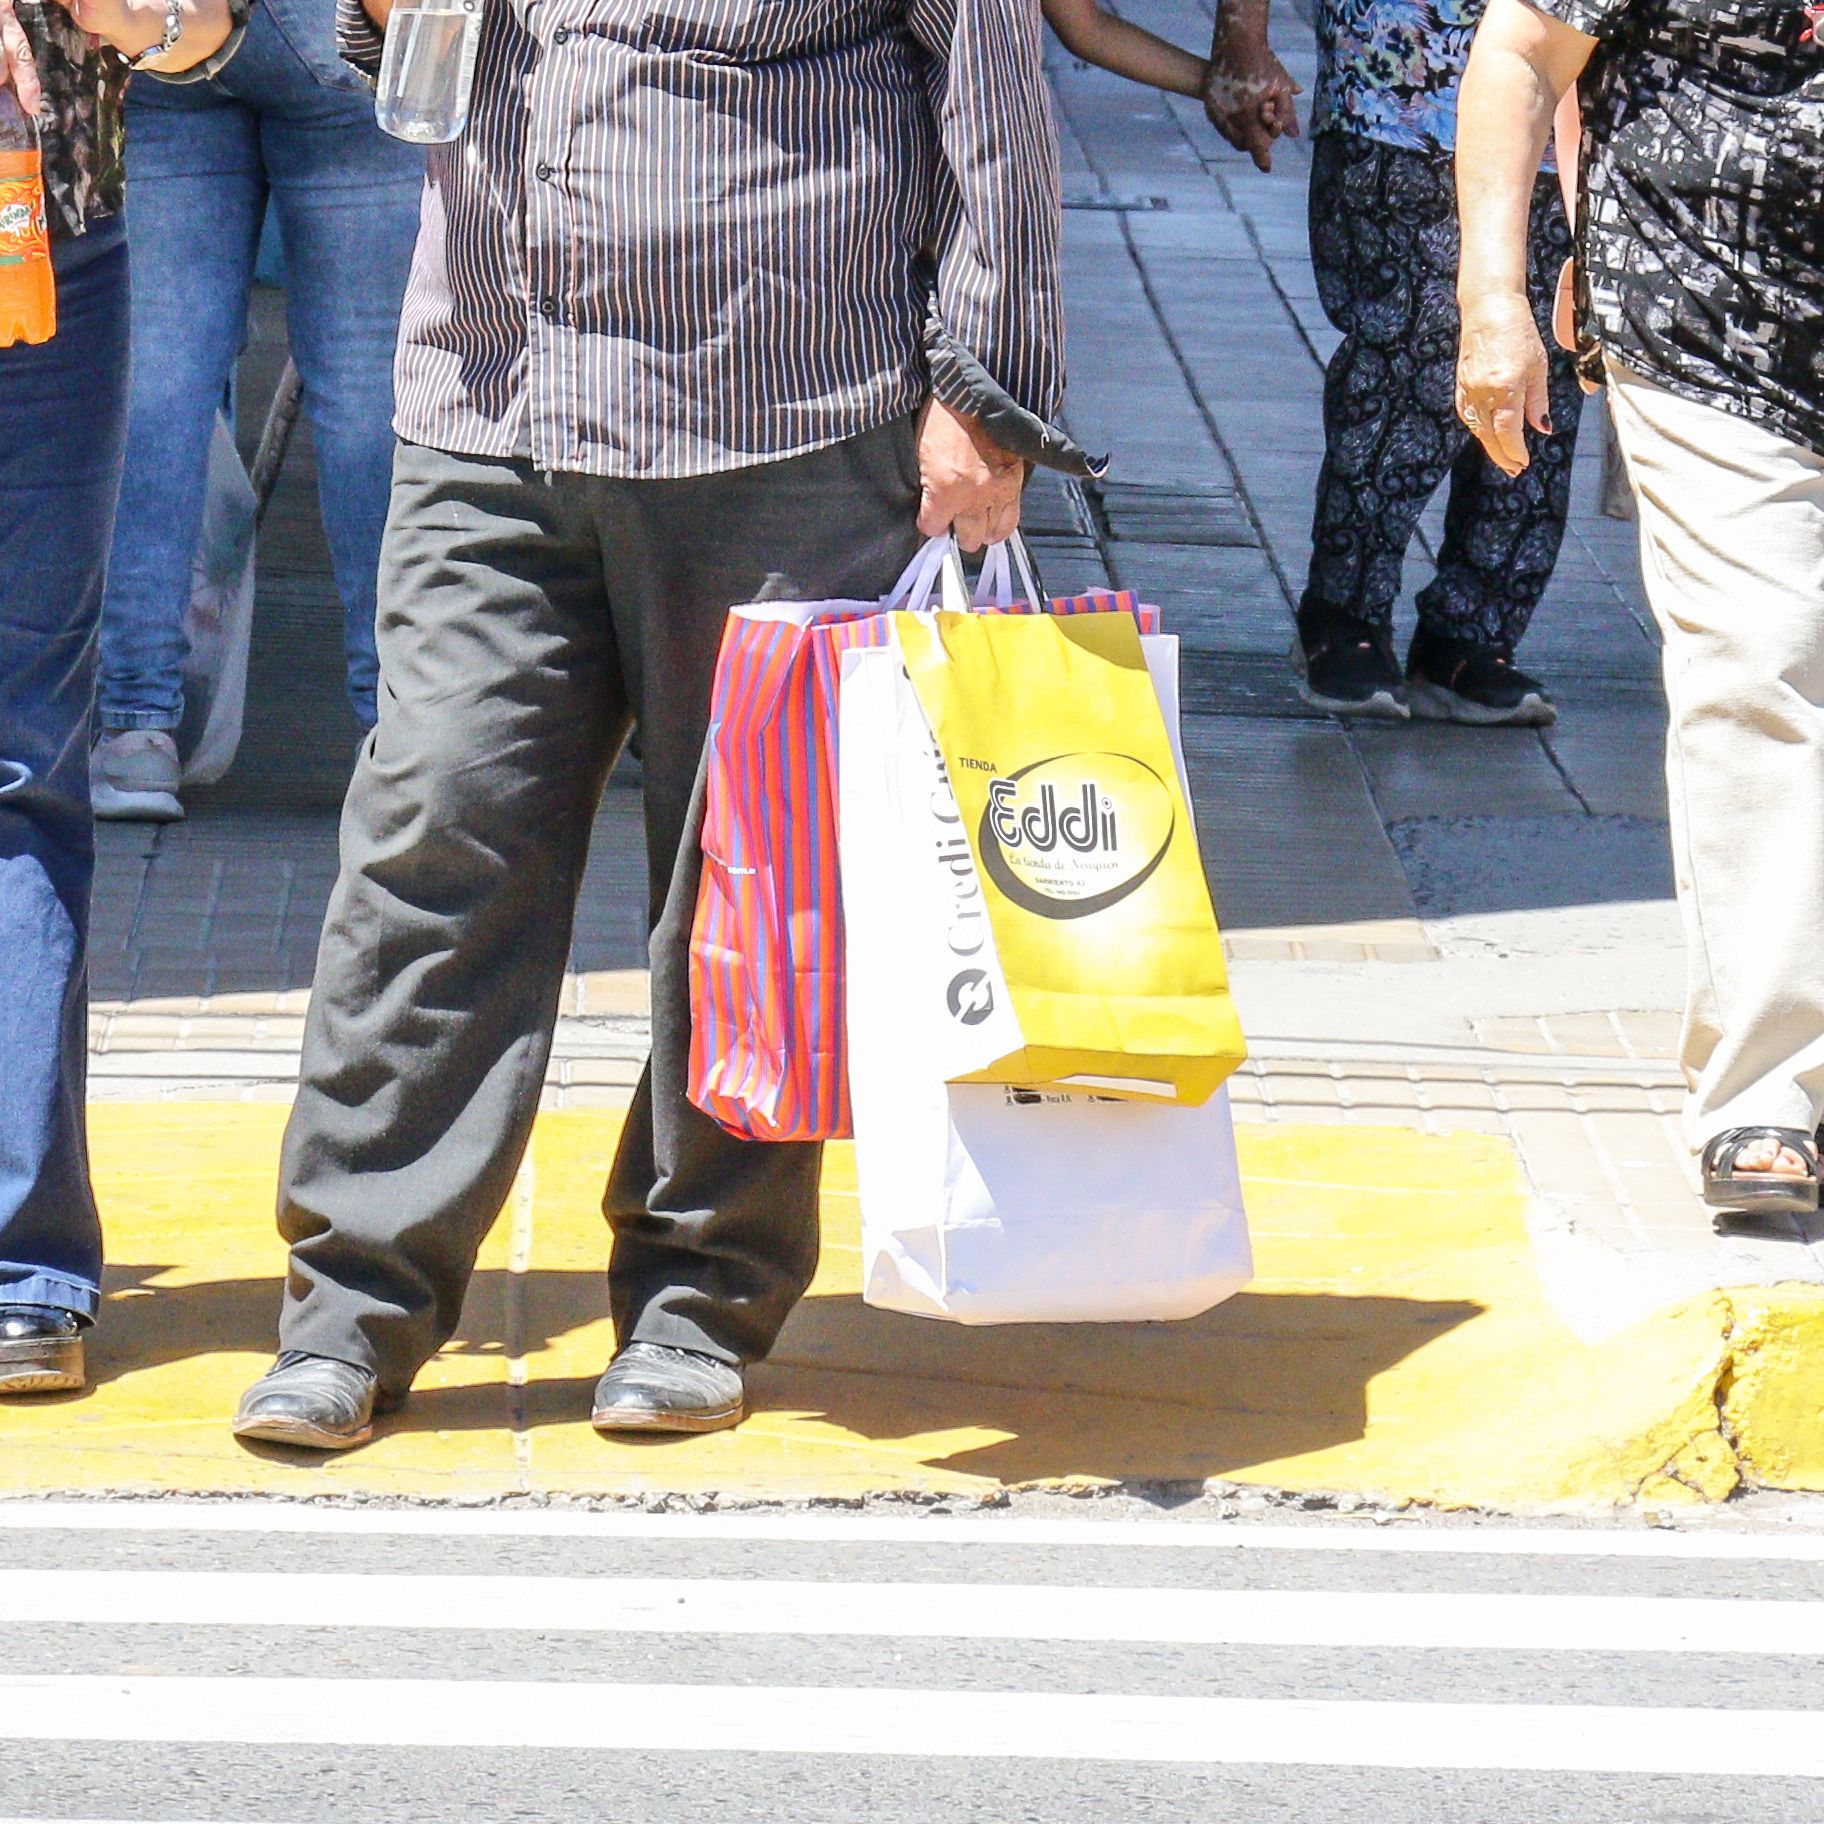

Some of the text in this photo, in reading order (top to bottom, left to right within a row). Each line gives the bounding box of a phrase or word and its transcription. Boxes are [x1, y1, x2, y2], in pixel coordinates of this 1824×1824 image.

[958, 756, 998, 774] TIENDA
[988, 778, 1118, 853] Eddi
[935, 839, 984, 957] Credi
